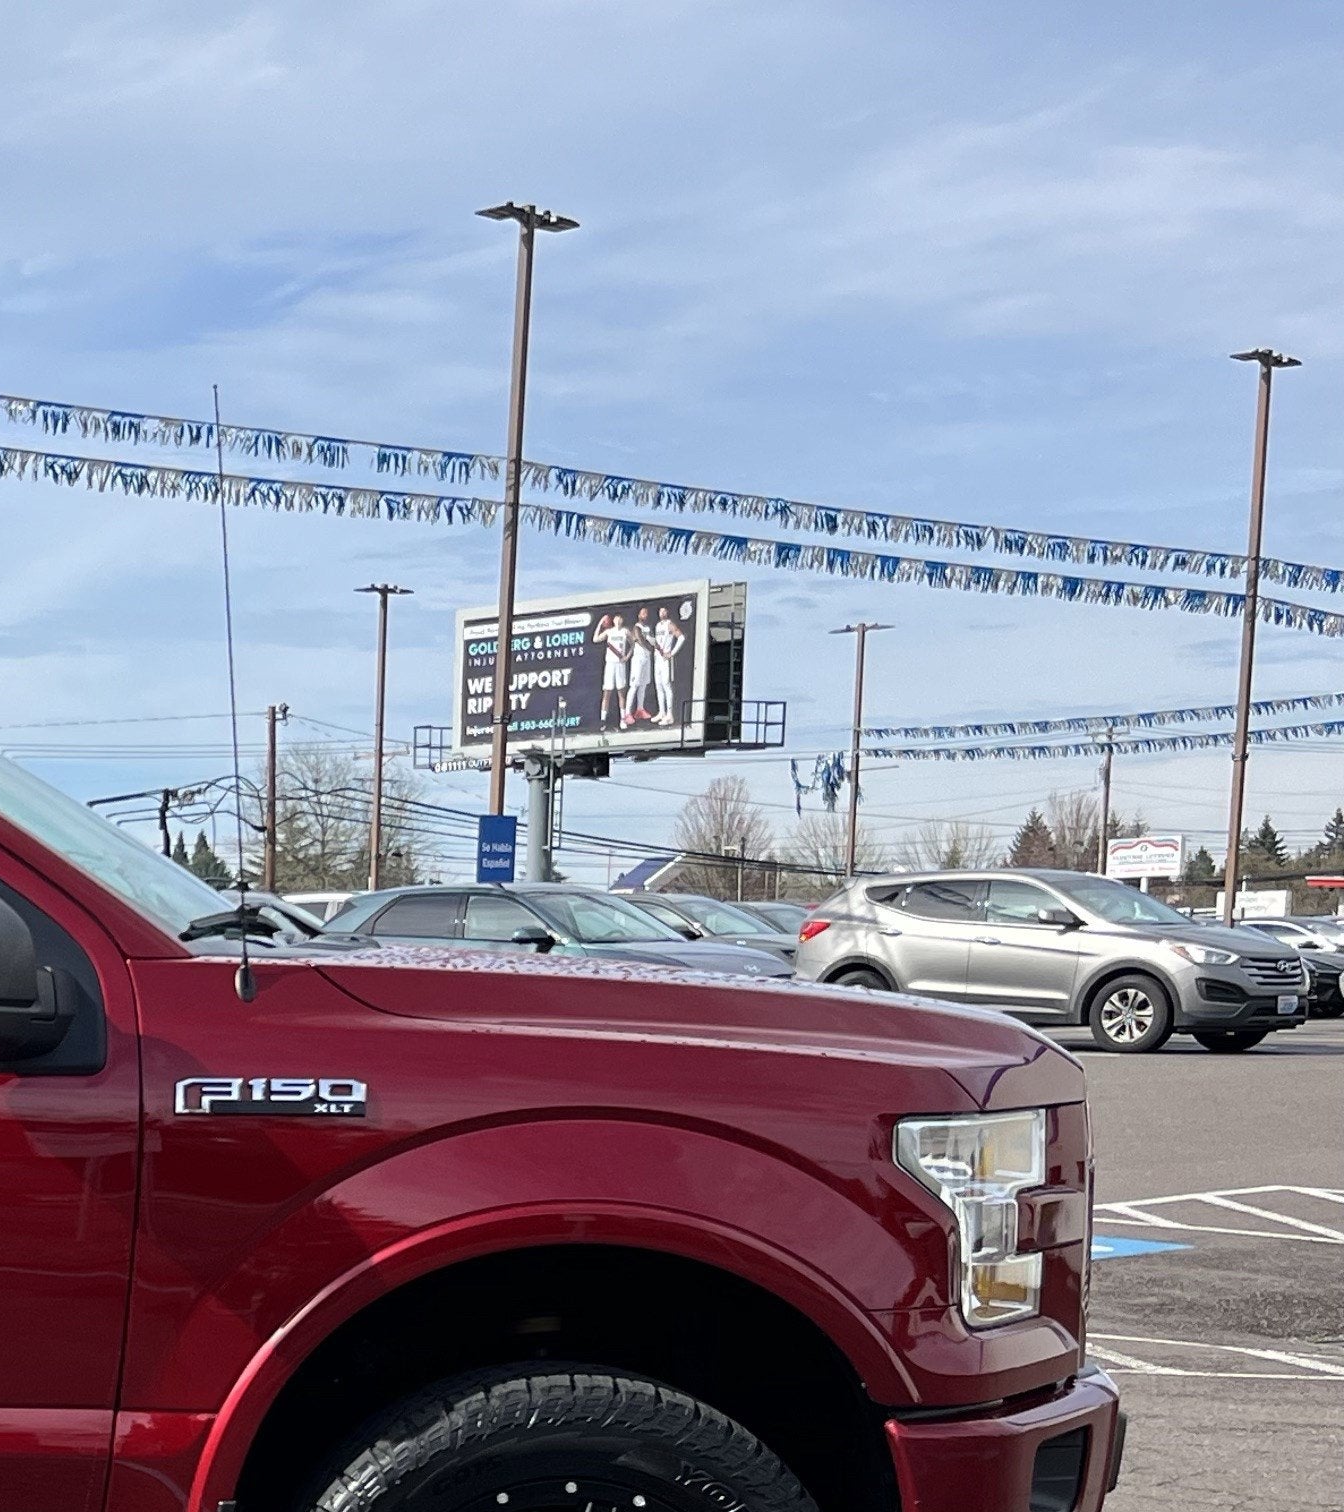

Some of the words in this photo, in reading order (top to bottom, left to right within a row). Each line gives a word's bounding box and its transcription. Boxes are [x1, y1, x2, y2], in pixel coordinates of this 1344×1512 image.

[468, 637, 531, 656] GOLDERG
[533, 635, 543, 650] &
[546, 631, 585, 648] LOREN
[468, 656, 495, 667] INJU
[515, 646, 585, 662] ATTORNEYS
[467, 676, 493, 695] WE
[509, 668, 572, 691] UPPORT
[467, 696, 493, 715] RIP
[481, 842, 491, 853] Se
[491, 841, 514, 853] Habla
[313, 1103, 355, 1114] XLT
